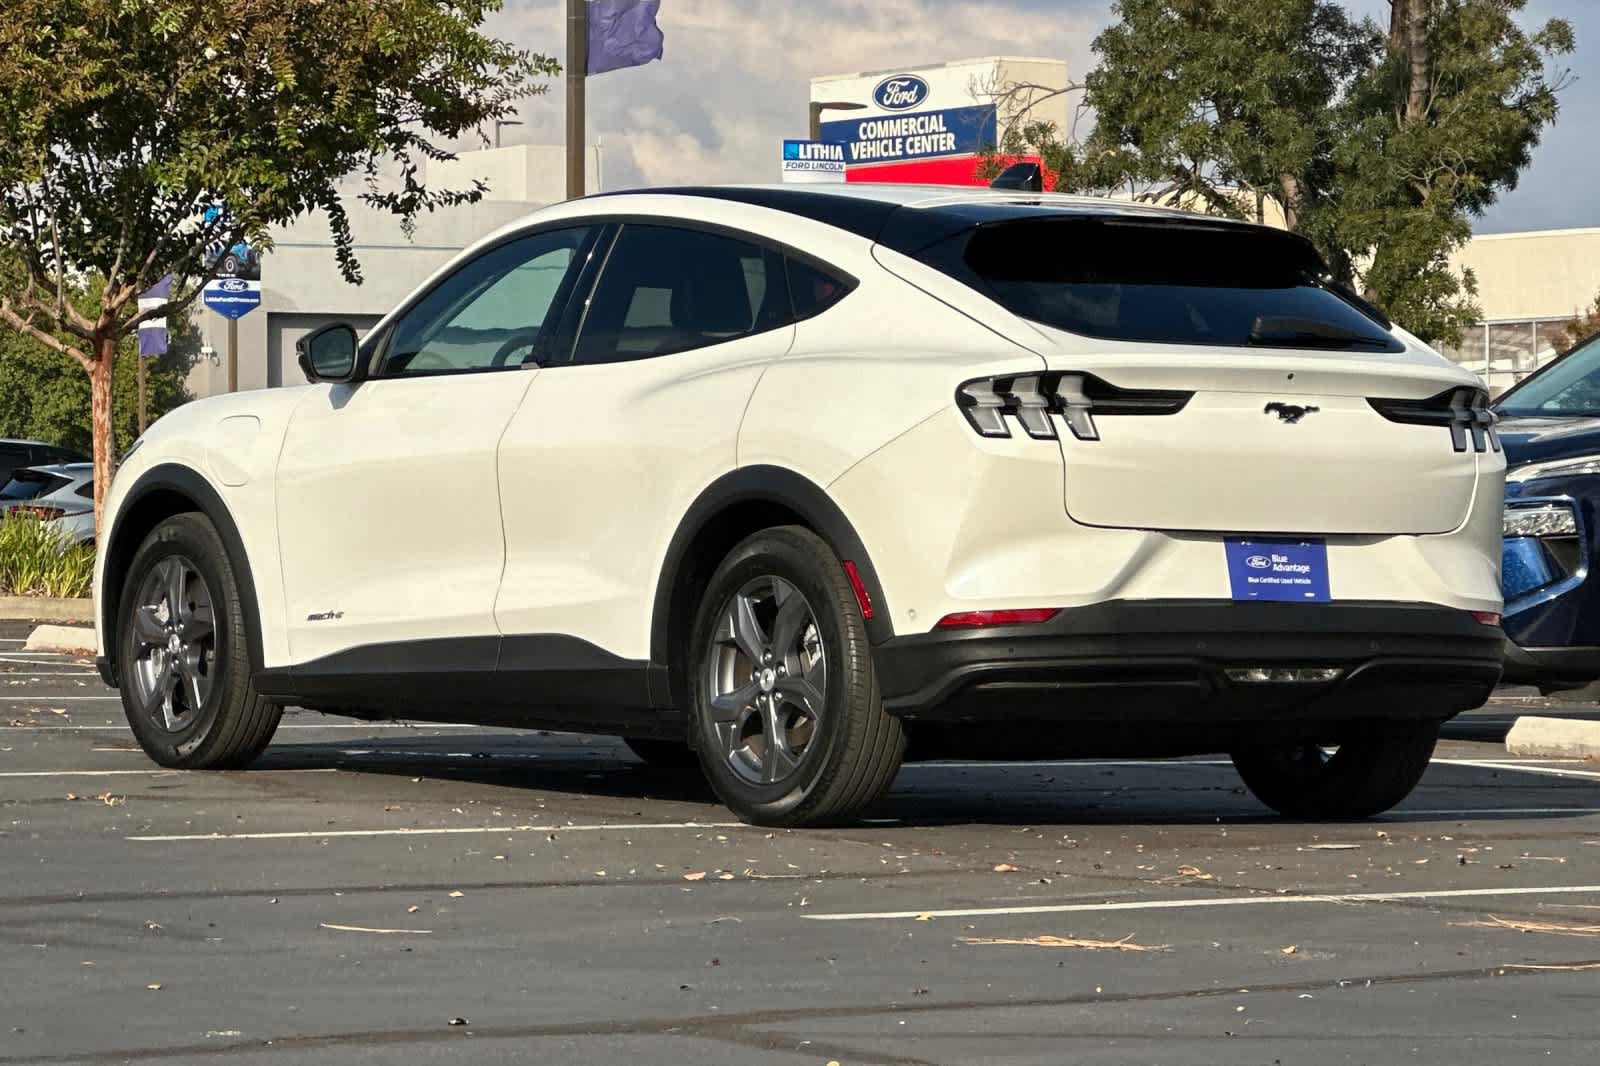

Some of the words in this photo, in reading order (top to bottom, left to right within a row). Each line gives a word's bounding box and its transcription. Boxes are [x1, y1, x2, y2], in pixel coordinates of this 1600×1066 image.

[883, 80, 918, 105] Ford
[859, 114, 947, 140] COMMERCIAL
[799, 143, 844, 160] LITHIA
[850, 137, 903, 160] VEHICLE
[905, 132, 956, 154] CENTER
[786, 161, 811, 169] FORD
[812, 162, 844, 170] LINCOLN
[223, 279, 246, 291] Ford
[1272, 554, 1289, 563] Blue
[1273, 563, 1311, 574] Advantage
